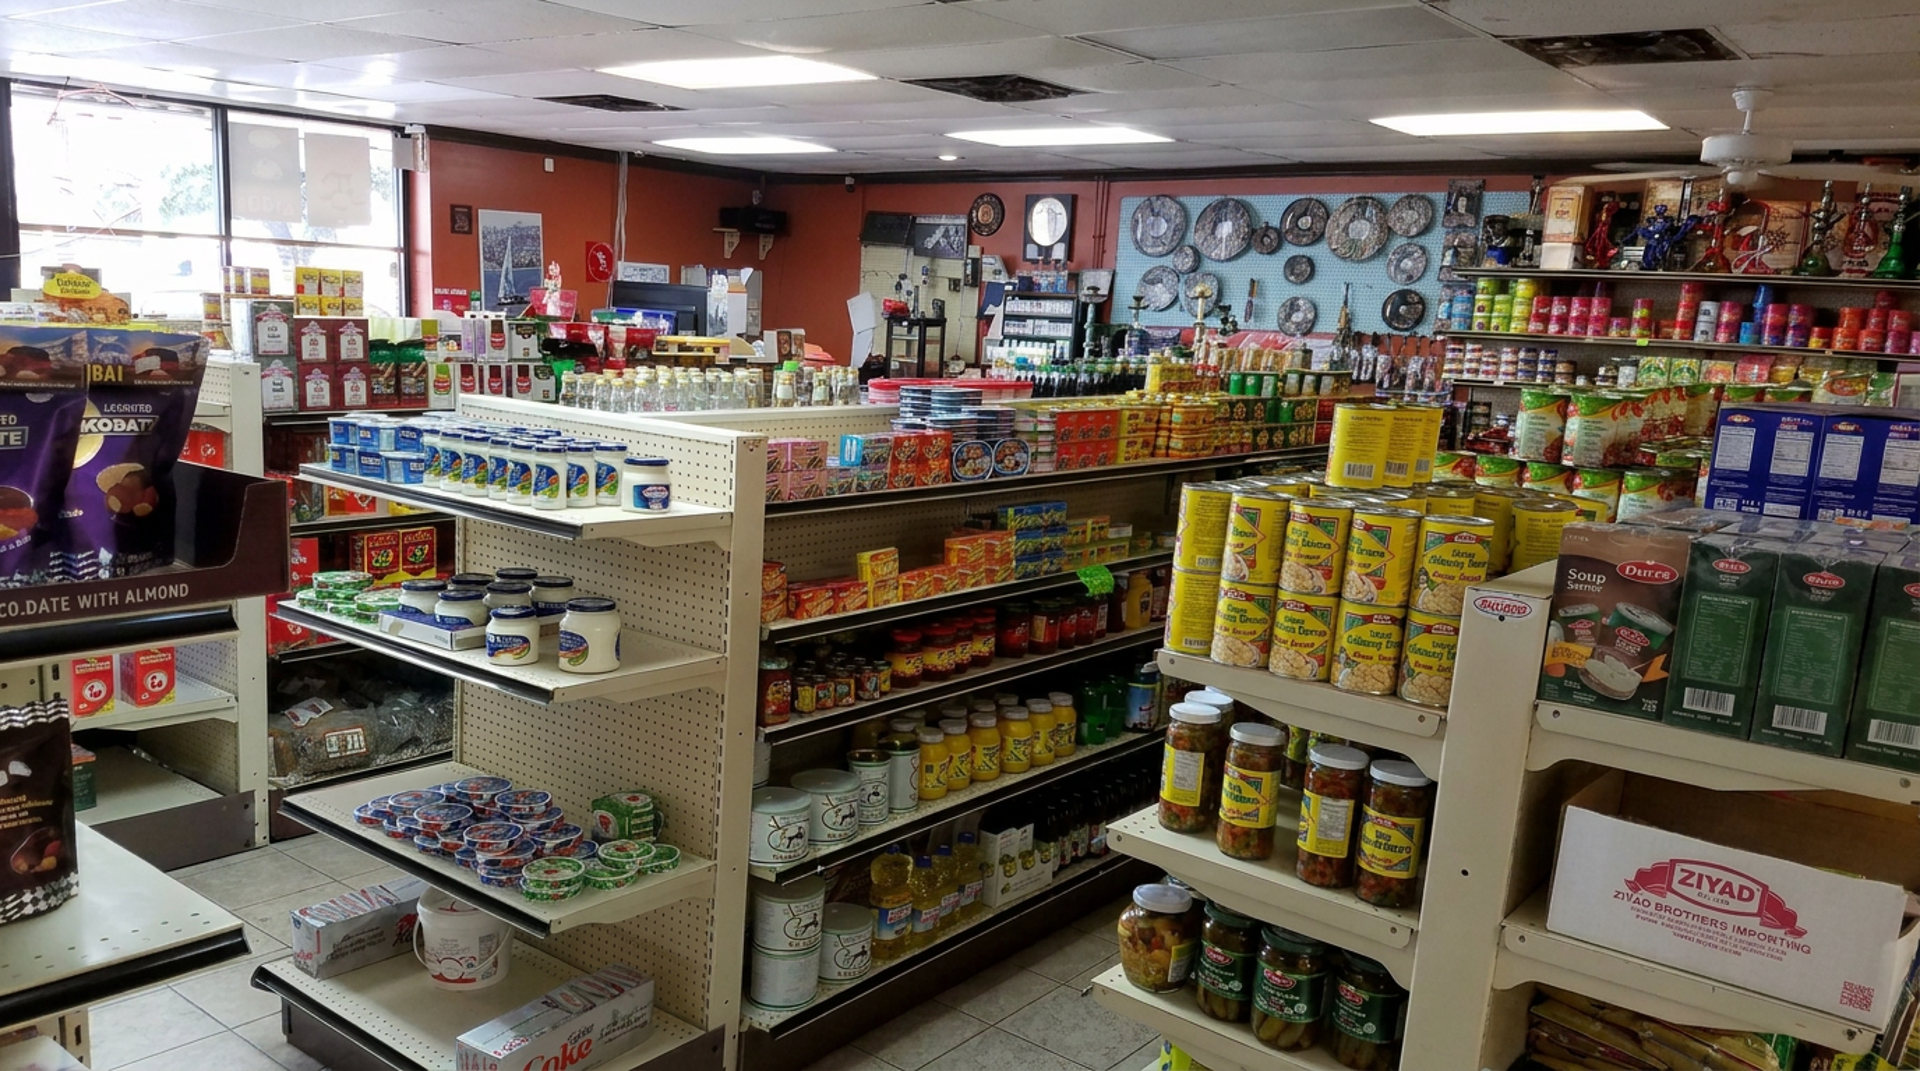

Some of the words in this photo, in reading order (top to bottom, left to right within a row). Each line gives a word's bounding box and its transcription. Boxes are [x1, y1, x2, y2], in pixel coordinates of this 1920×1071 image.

[1567, 568, 1606, 584] Soup
[77, 591, 119, 609] WITH
[125, 583, 189, 604] ALMOND
[1677, 868, 1755, 903] ZIYAD
